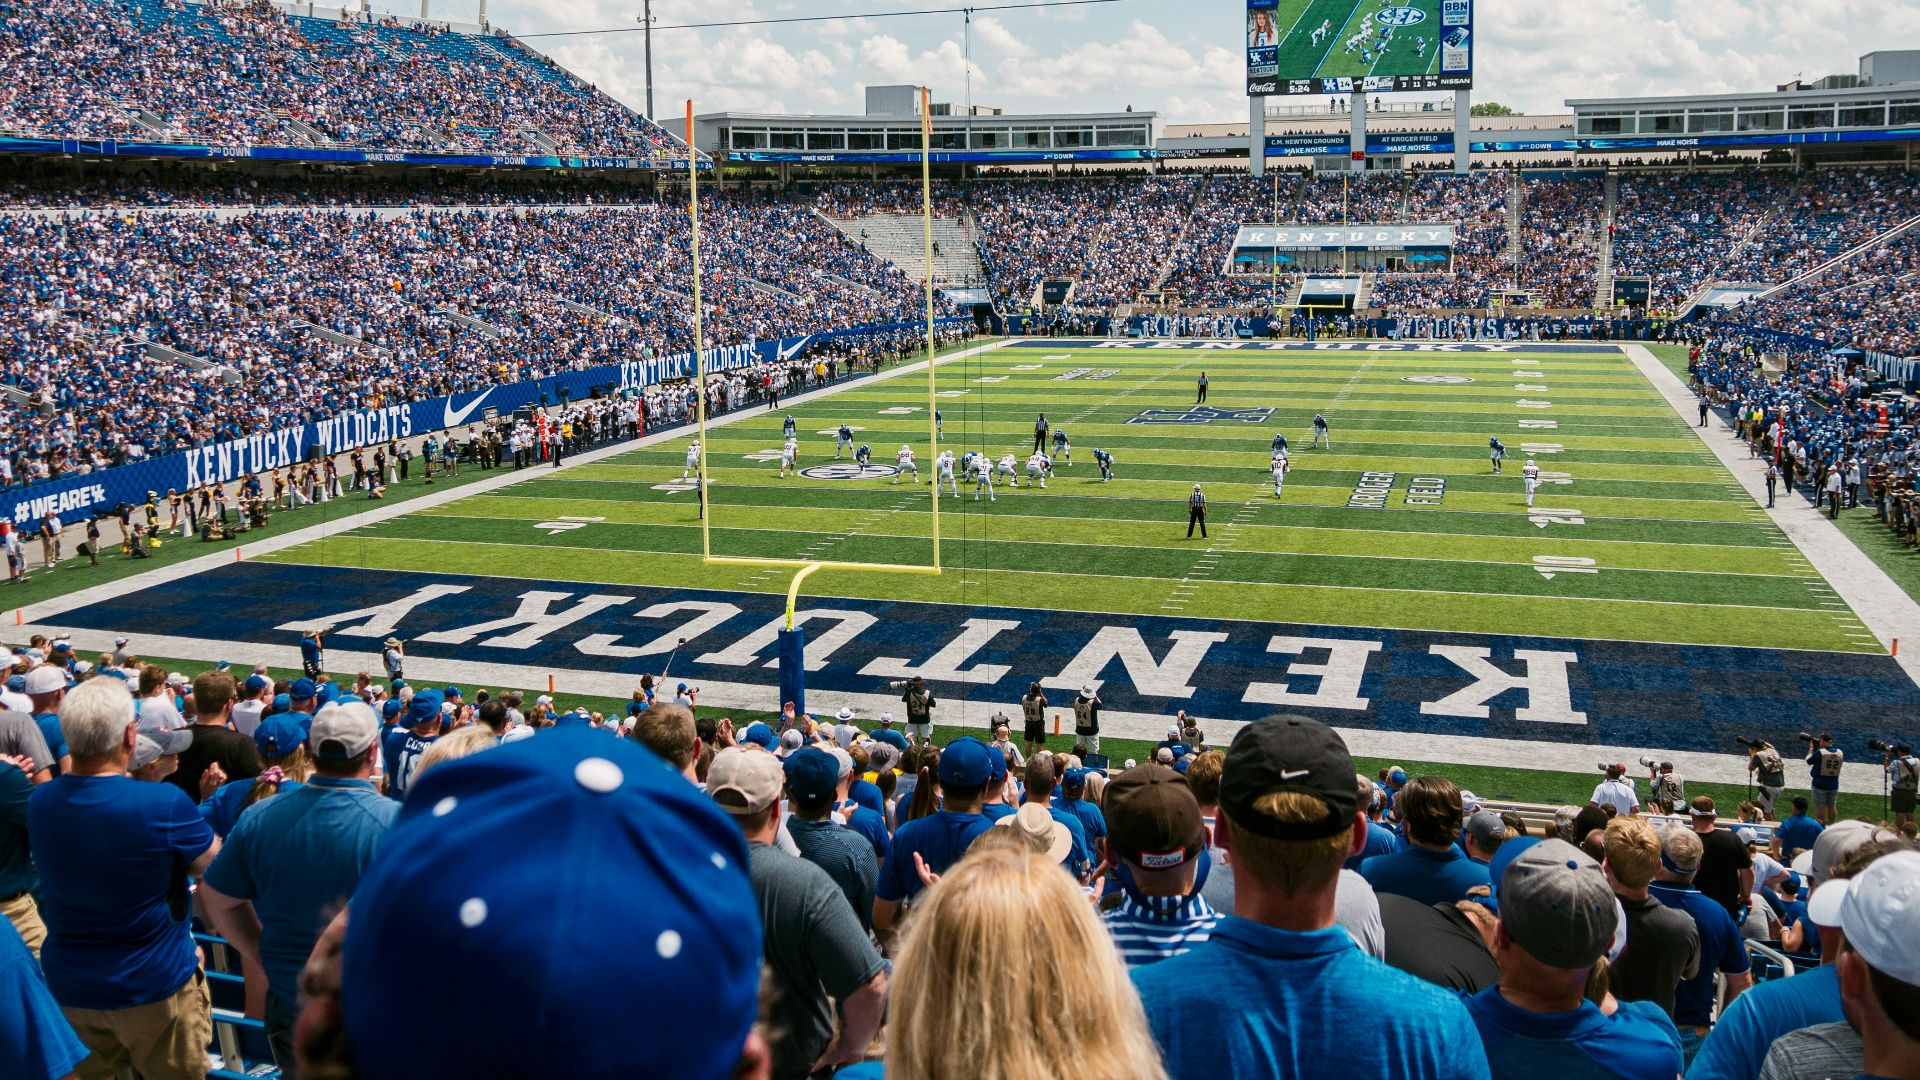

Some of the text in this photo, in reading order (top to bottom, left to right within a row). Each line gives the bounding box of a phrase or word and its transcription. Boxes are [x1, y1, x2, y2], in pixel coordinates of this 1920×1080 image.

[1445, 2, 1467, 10] BBN
[1378, 9, 1420, 24] SEC
[1289, 85, 1310, 93] 5:24
[1530, 142, 1552, 150] DOWN
[1656, 138, 1699, 147] MAKE NOISE
[223, 147, 250, 157] DOWN
[1053, 152, 1075, 160] DOWN
[1353, 152, 1363, 160] 35
[365, 153, 404, 162] MAKE NOISE
[504, 157, 526, 165] DOWN
[818, 154, 835, 162] NOISE
[591, 159, 600, 168] 14
[615, 159, 624, 168] 14
[1249, 231, 1443, 242] KENTUCKY
[1089, 341, 1521, 352] KENTUCKY
[621, 353, 691, 390] KENTUCKY
[186, 403, 412, 490] KENTUCKY WILDCATS
[1274, 461, 1282, 469] 10
[1405, 477, 1445, 505] FIELD
[273, 583, 1588, 725] KENTUCKY
[1026, 707, 1036, 716] 28
[1826, 760, 1839, 770] 62
